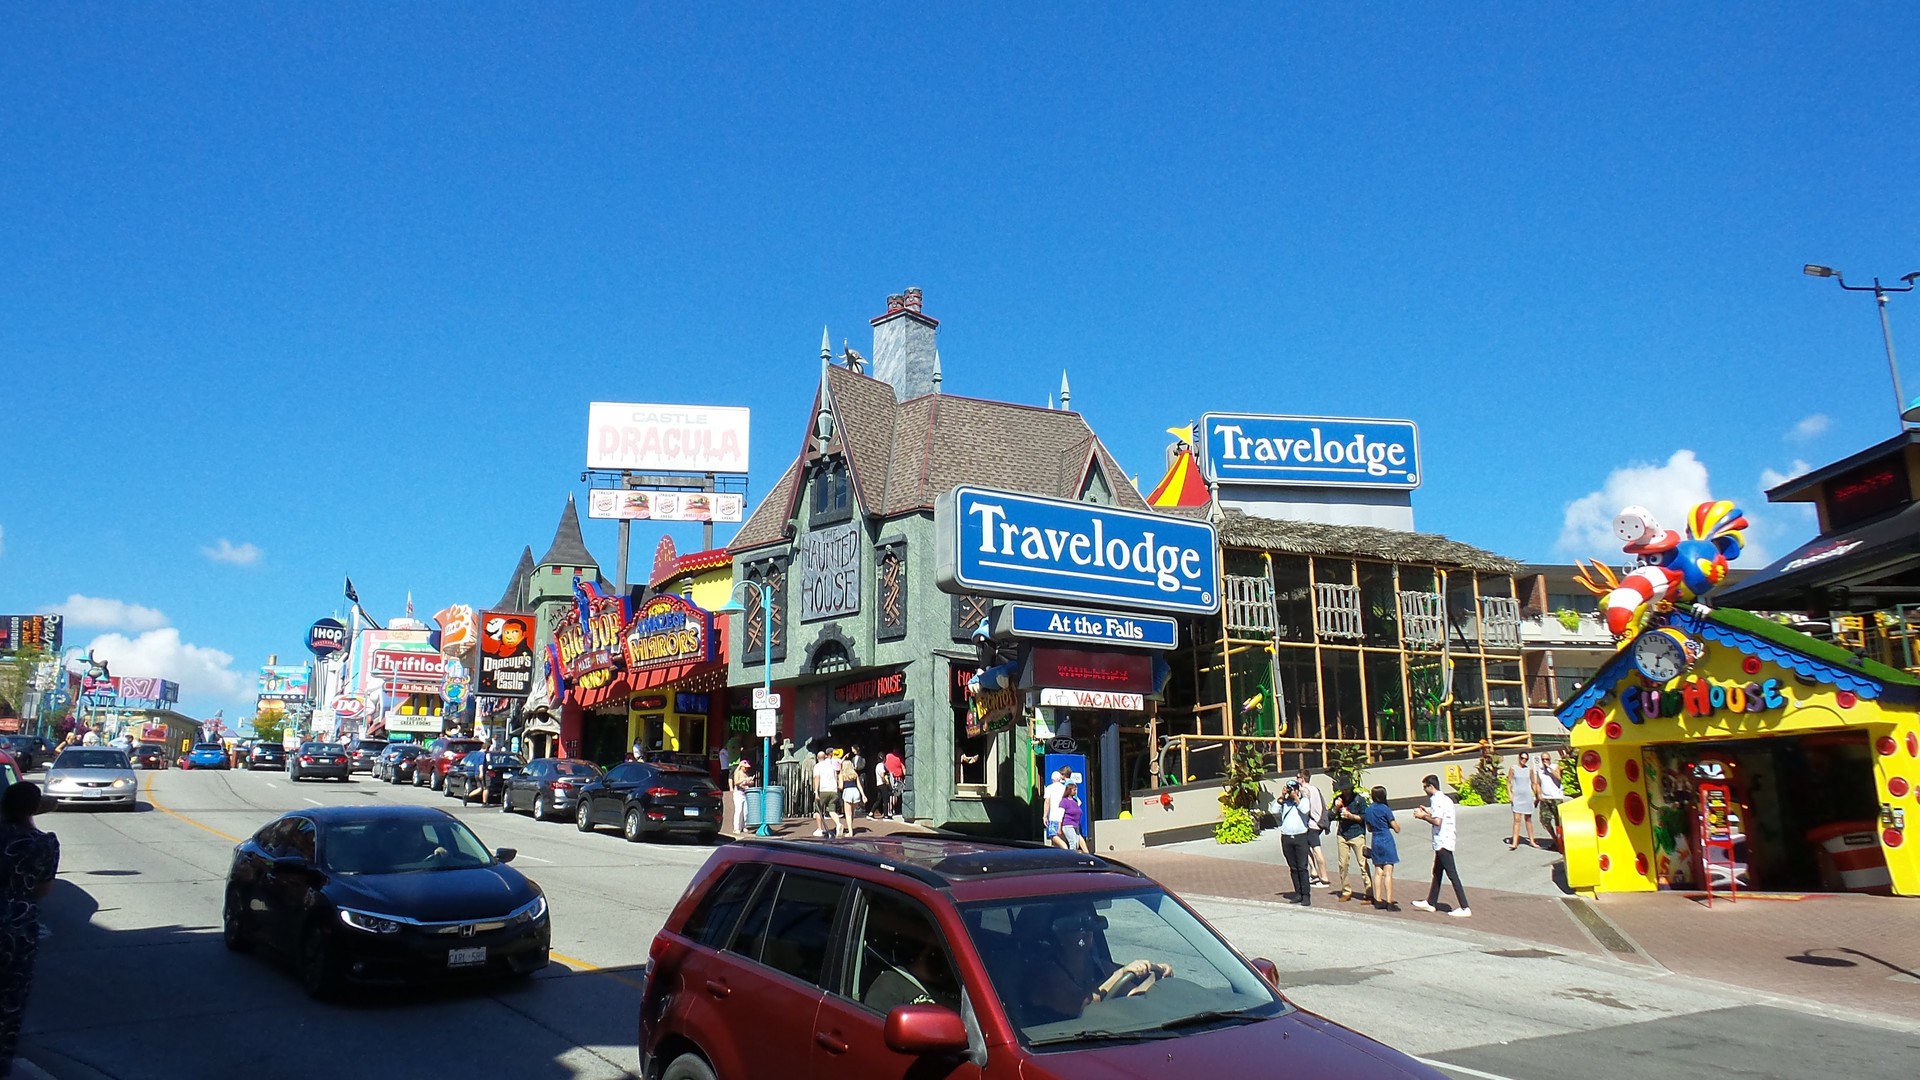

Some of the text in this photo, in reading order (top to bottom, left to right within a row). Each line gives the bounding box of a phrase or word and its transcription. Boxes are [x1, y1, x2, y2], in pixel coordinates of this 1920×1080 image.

[632, 412, 708, 424] CASTLE
[599, 425, 742, 467] DRACULA
[1214, 424, 1406, 476] Travelodge
[821, 528, 838, 541] THE
[801, 531, 857, 572] HAUNTED
[969, 501, 1201, 591] Travelodge
[801, 570, 855, 617] HOUSE
[314, 628, 342, 643] IHOP
[1048, 613, 1143, 640] At the Falls
[559, 613, 619, 664] BIG TOP
[631, 627, 699, 662] MIRRORS
[376, 654, 448, 673] Thriftlod
[493, 670, 529, 681] Haunted
[496, 679, 524, 690] Castle
[877, 673, 903, 698] HOUSE
[423, 684, 438, 692] Falls
[336, 700, 358, 712] DQ
[1075, 692, 1140, 708] VACANCY
[1620, 678, 1784, 724] FUN HOUSE
[1053, 739, 1076, 749] OPEN
